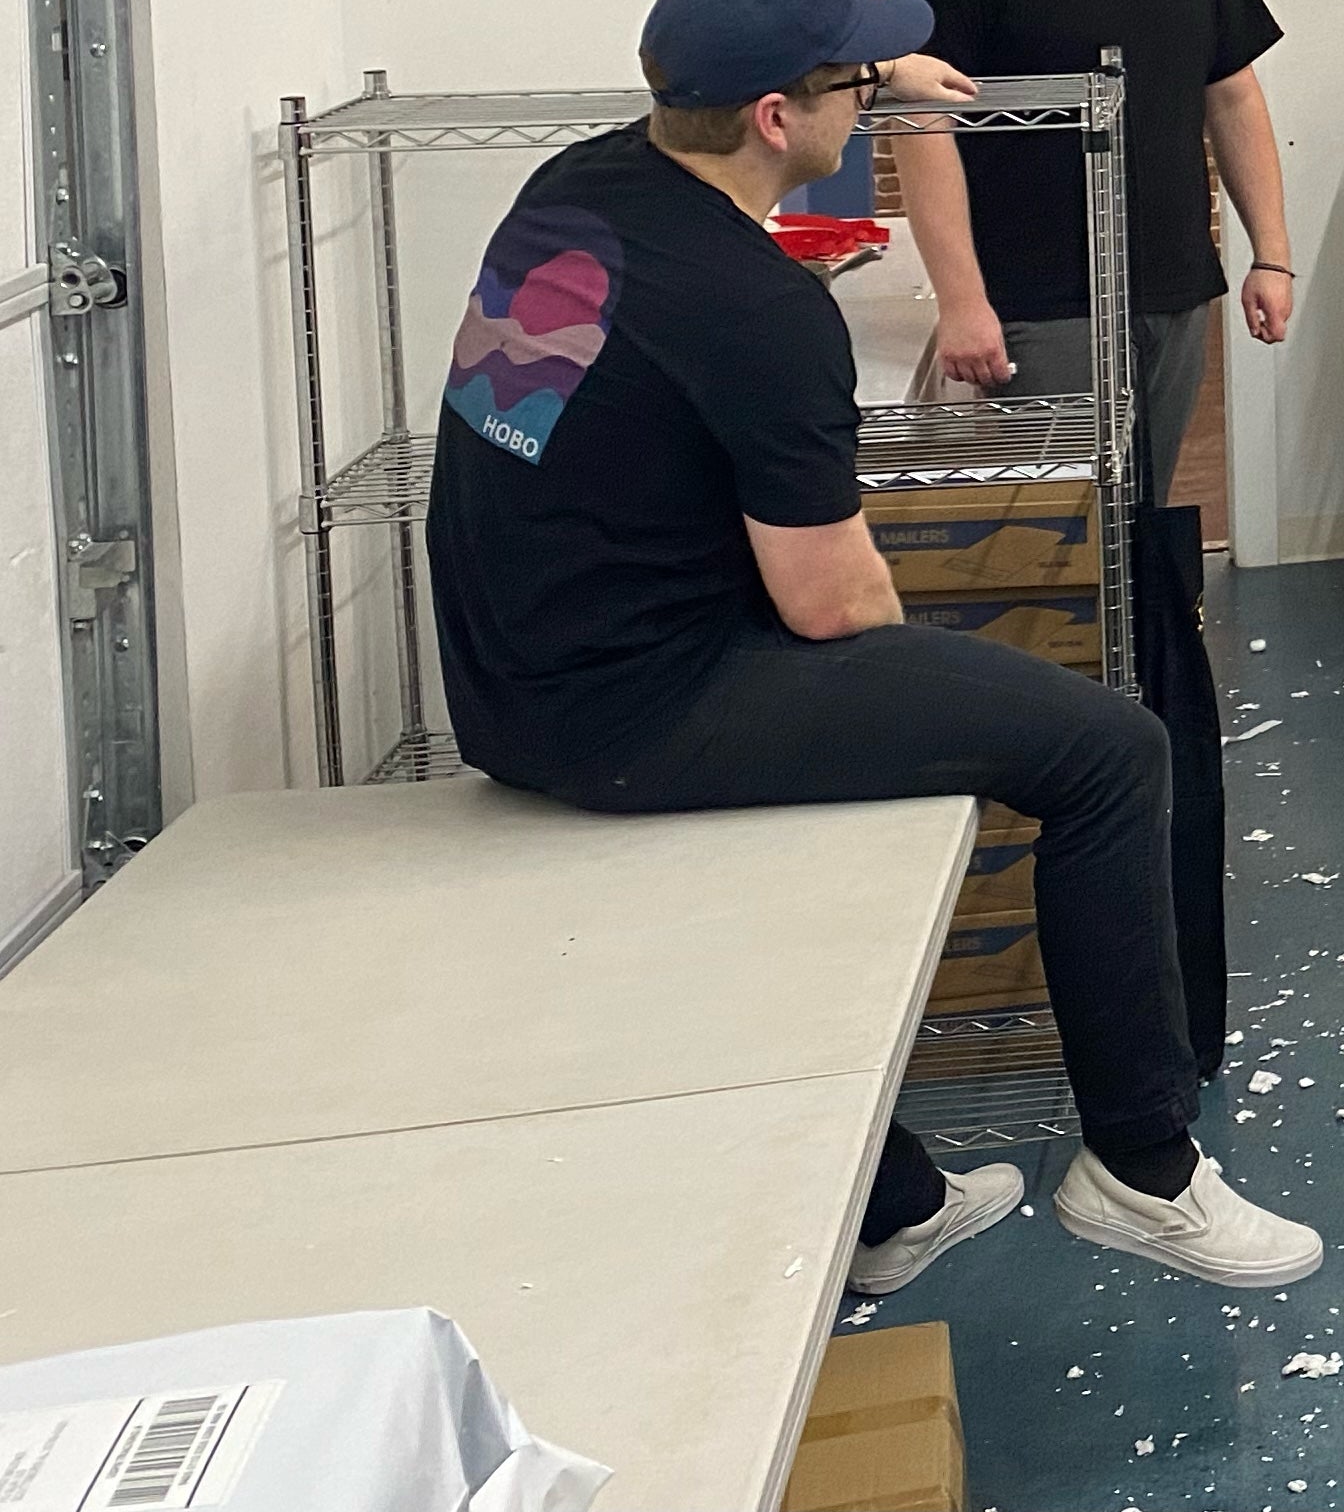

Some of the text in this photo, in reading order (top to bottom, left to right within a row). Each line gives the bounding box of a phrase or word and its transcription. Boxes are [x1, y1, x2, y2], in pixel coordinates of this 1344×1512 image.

[482, 414, 539, 458] HOBO
[880, 529, 949, 544] MAILERS
[905, 611, 961, 625] AILERS
